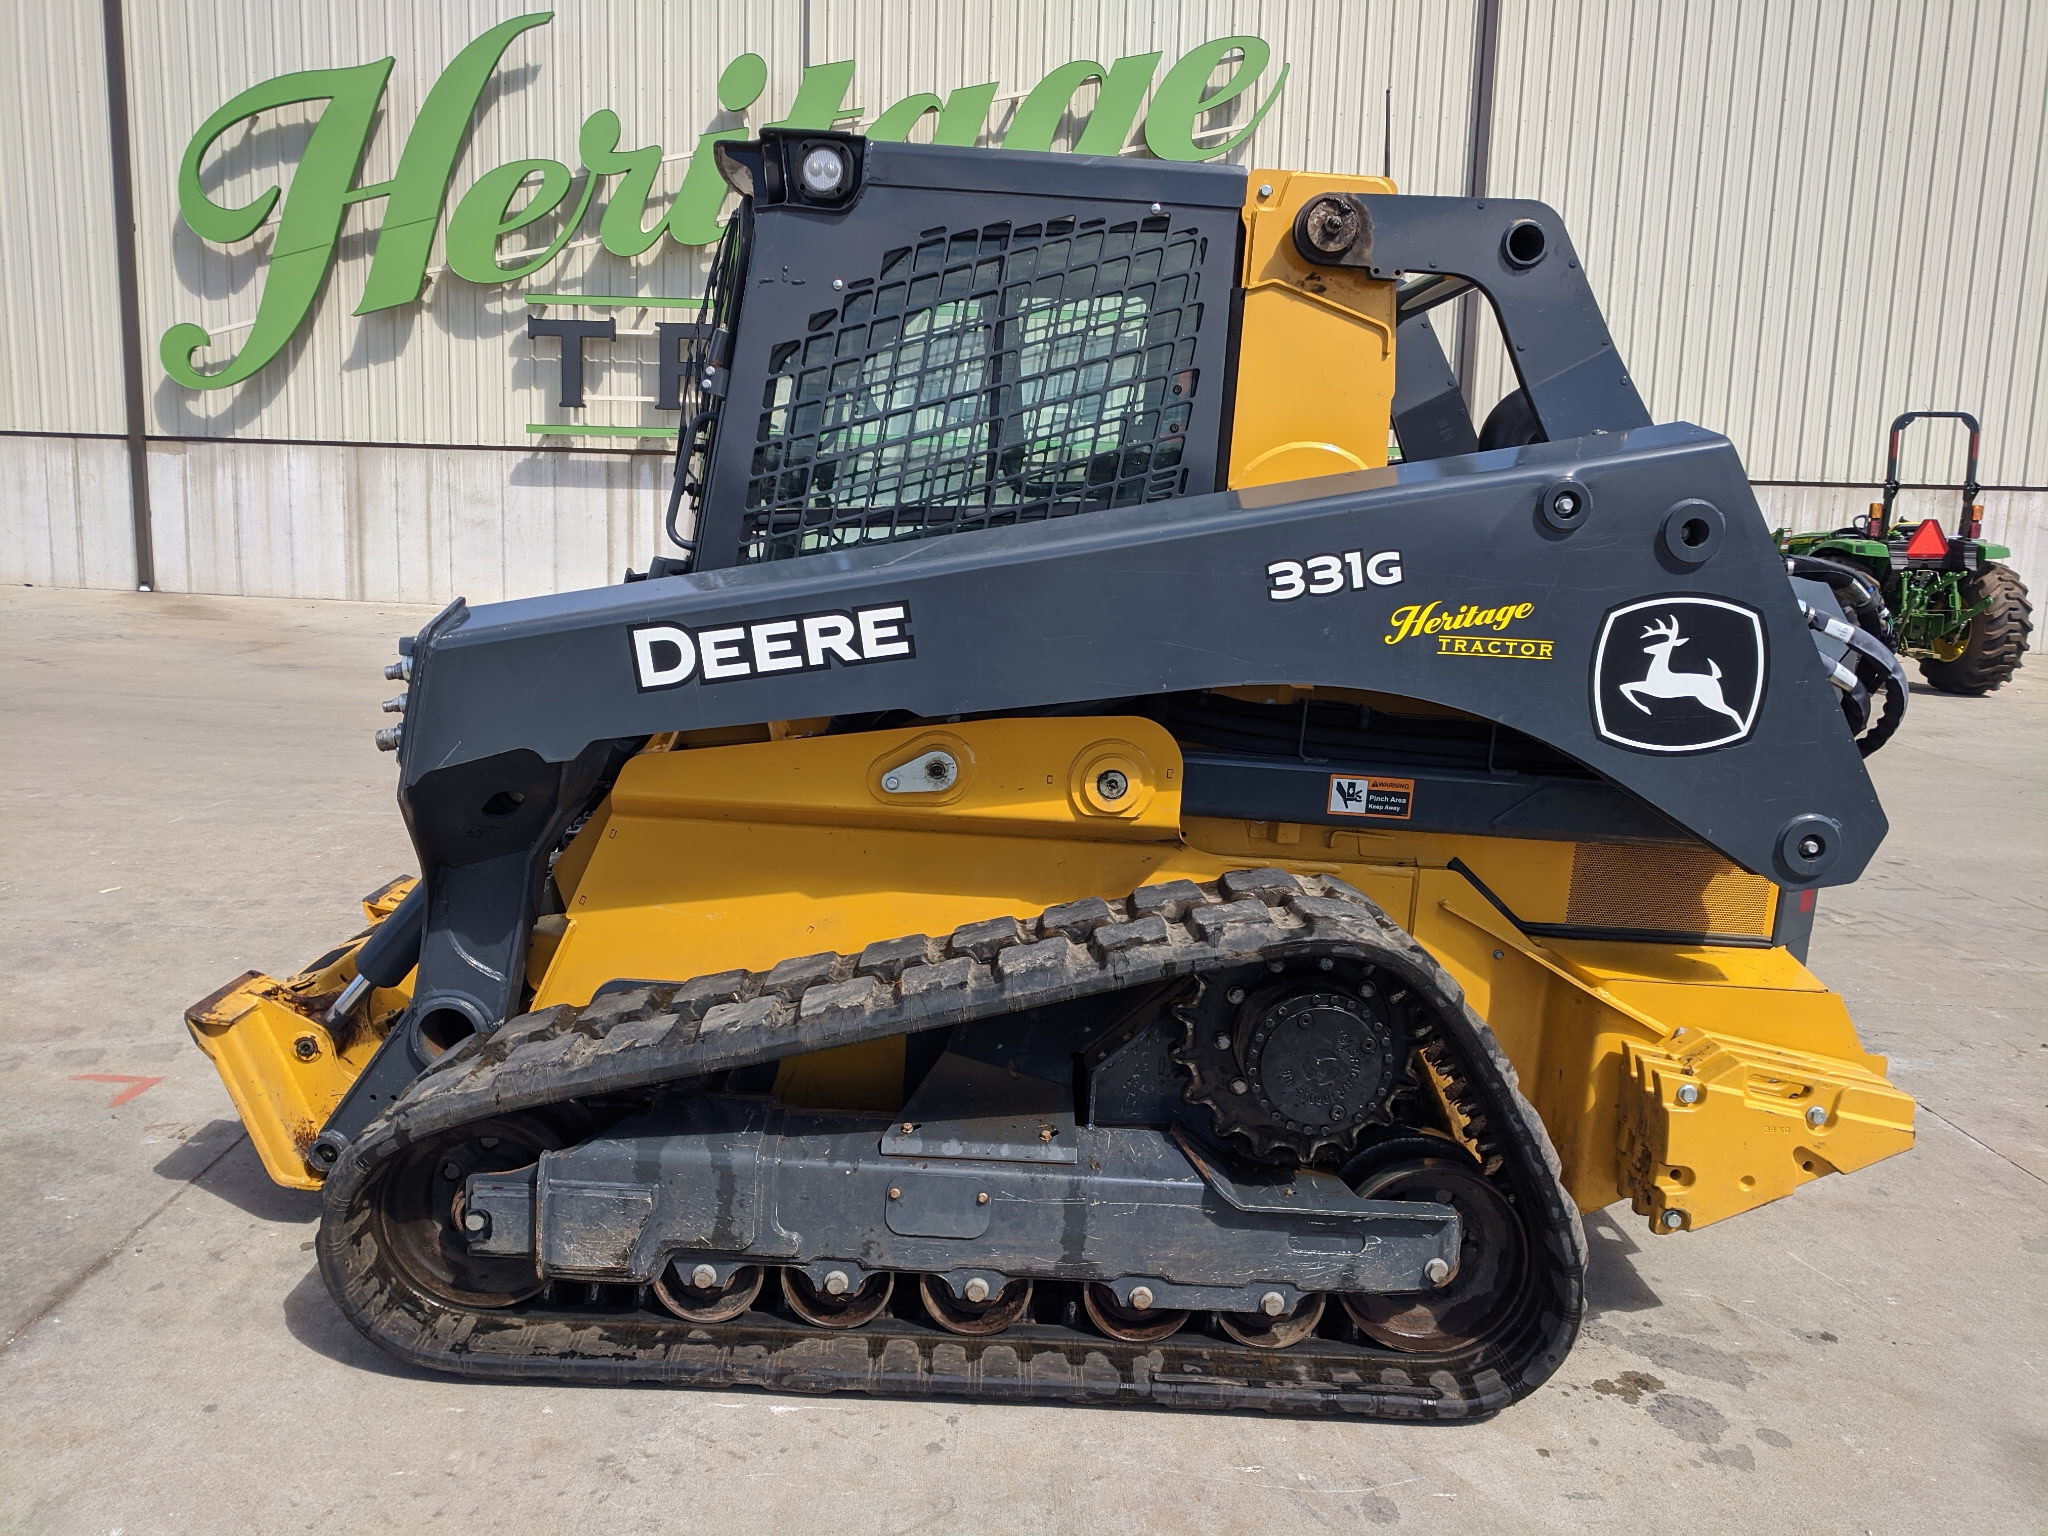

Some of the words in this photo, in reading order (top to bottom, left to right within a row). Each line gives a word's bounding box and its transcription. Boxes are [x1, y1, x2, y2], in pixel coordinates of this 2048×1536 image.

[1268, 551, 1403, 600] 331G
[1384, 600, 1536, 645] Heritage
[632, 606, 910, 689] DEERE
[1437, 638, 1553, 657] TRACTOR
[1378, 781, 1410, 790] WARNING
[1368, 803, 1384, 811] Keep
[1384, 804, 1401, 812] Away
[1369, 794, 1389, 803] Pinch
[1389, 796, 1407, 804] Area
